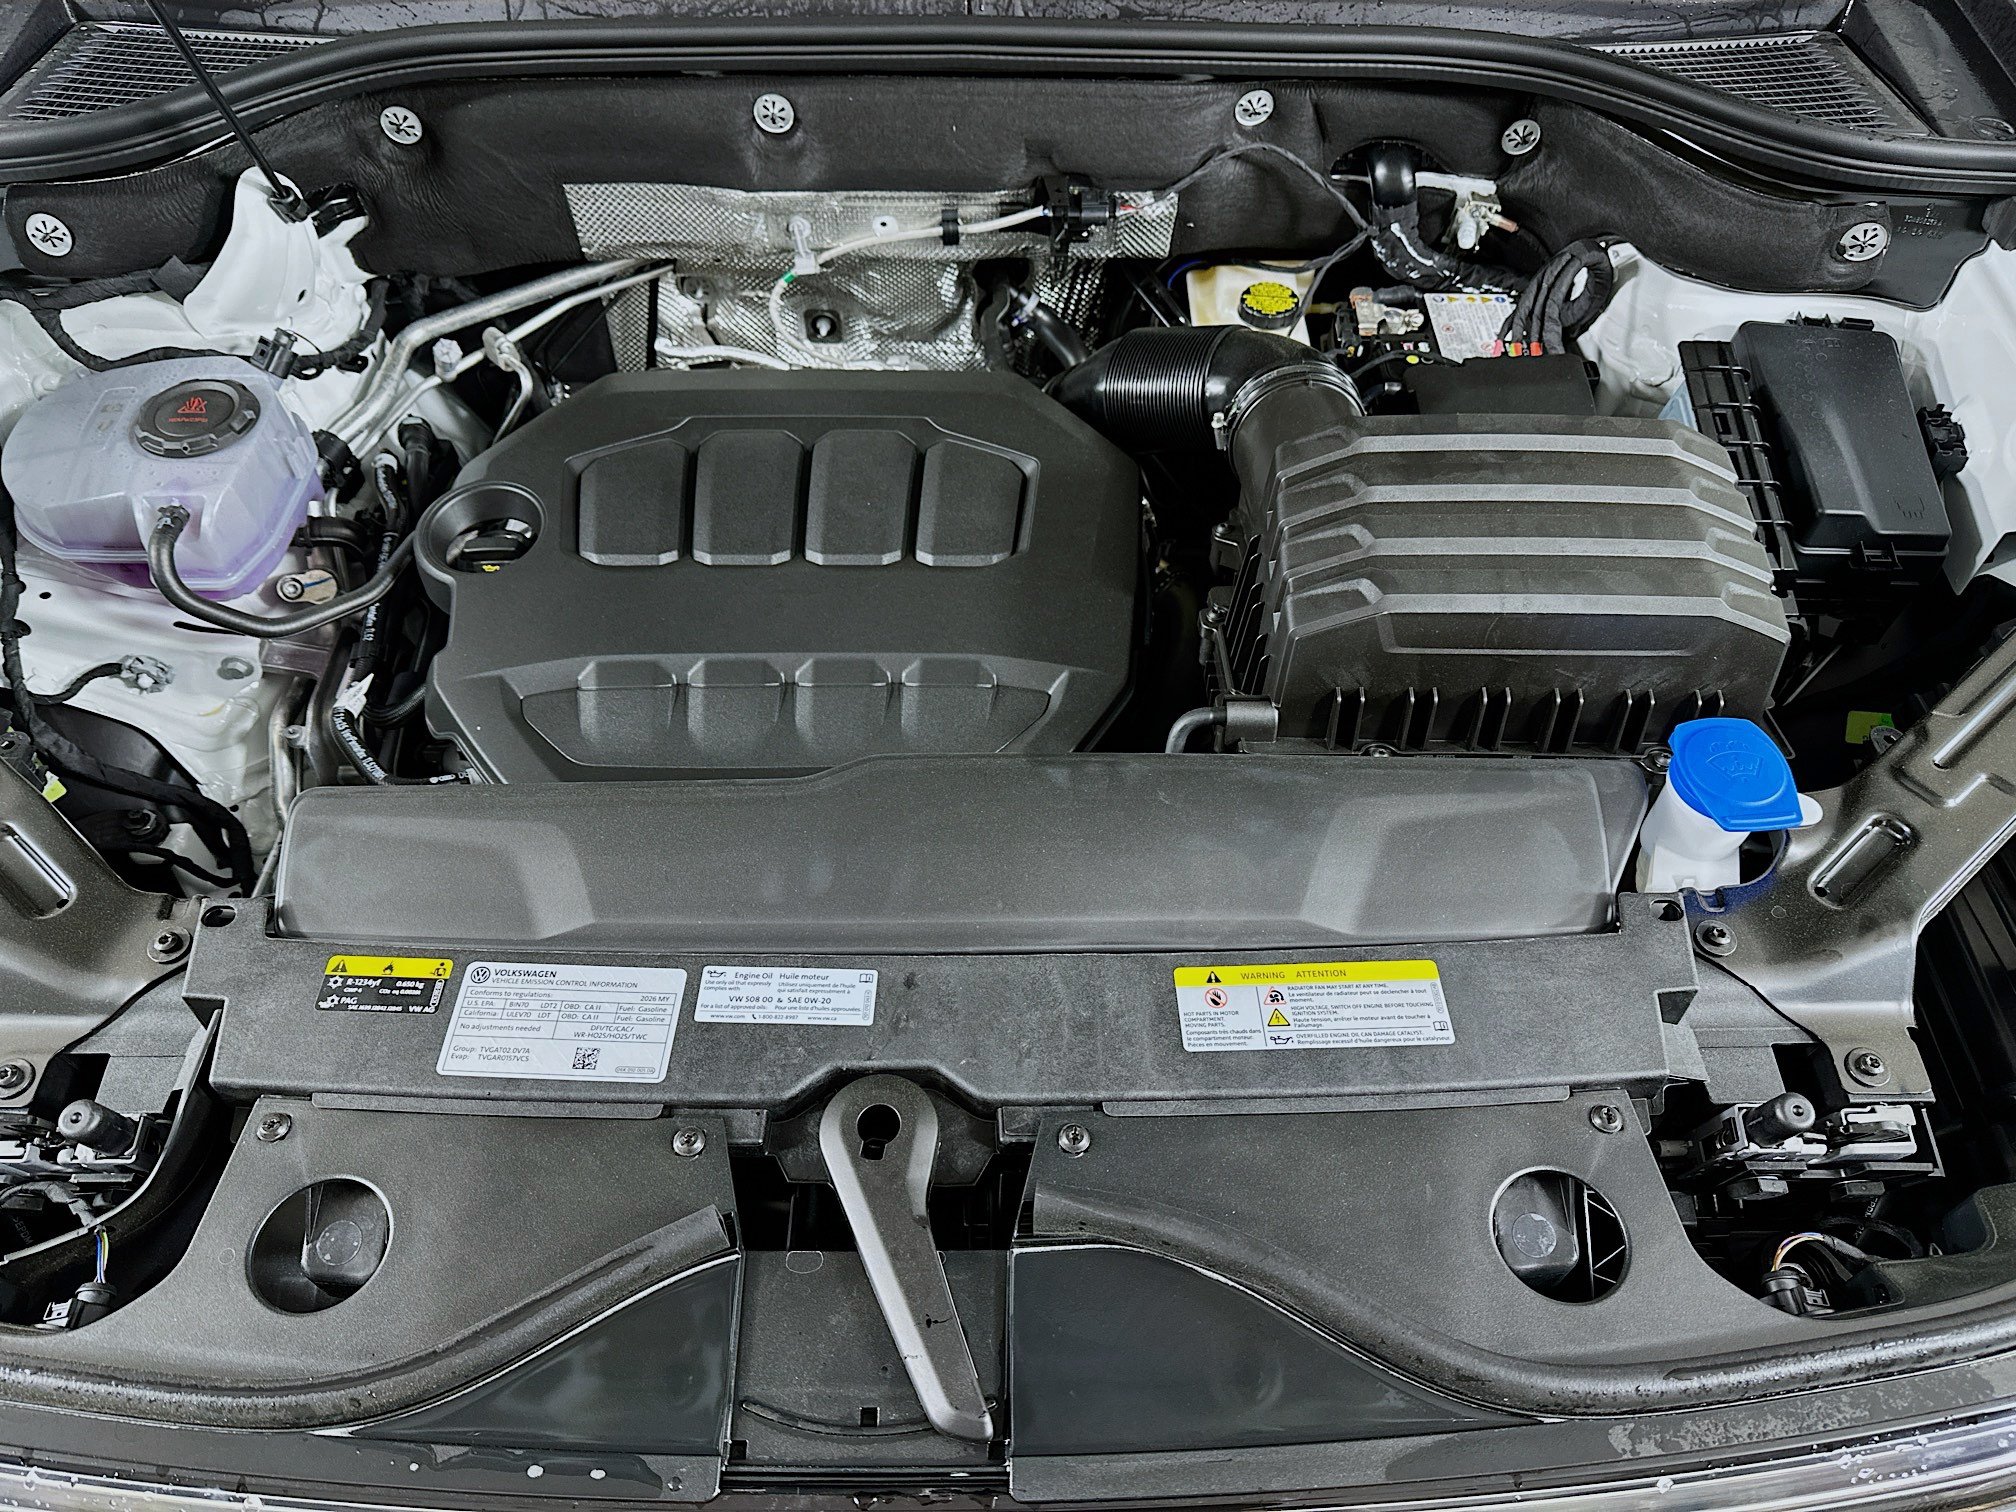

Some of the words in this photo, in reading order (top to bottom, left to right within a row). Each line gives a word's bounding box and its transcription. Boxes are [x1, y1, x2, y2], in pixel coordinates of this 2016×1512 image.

[493, 968, 557, 977] VOLKSWAGEN
[1240, 971, 1285, 979] WARNING
[1295, 969, 1346, 977] ATTENTION
[339, 996, 358, 1004] PAG
